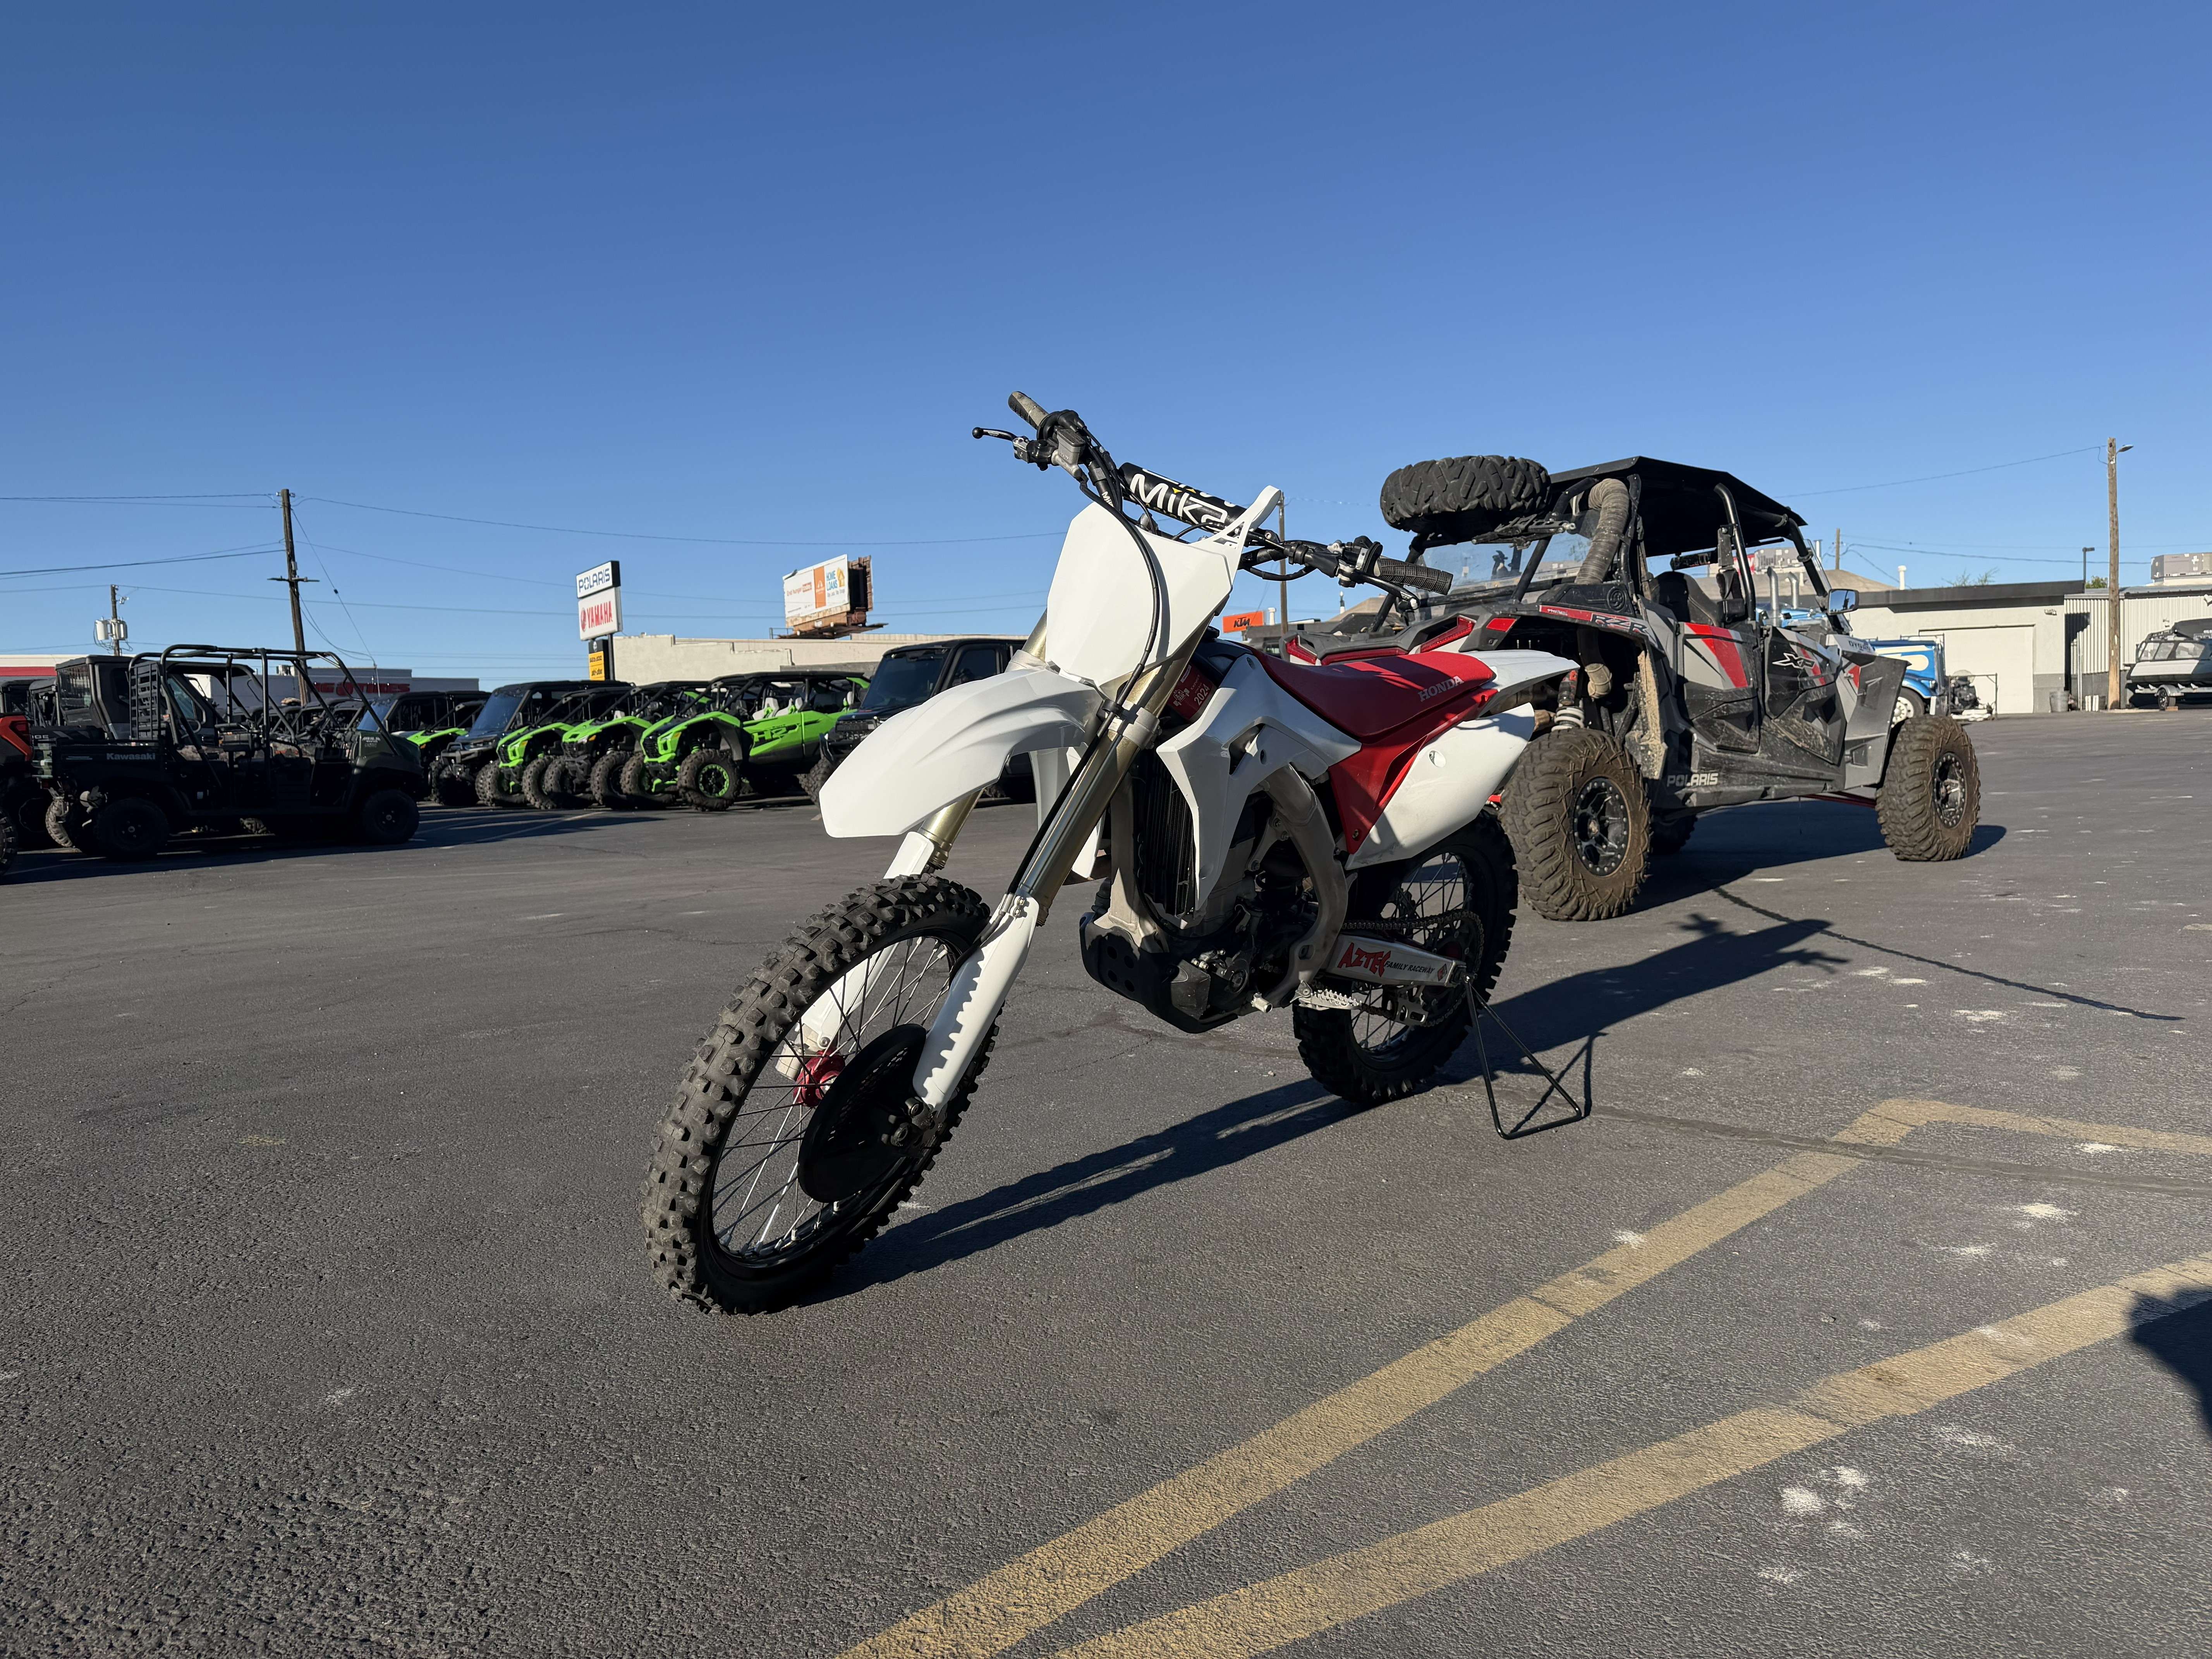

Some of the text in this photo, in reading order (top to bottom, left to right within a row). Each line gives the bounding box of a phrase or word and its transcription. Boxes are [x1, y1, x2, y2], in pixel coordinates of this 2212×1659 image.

[1130, 473, 1228, 532] Mika
[578, 568, 610, 593] POLARIS
[827, 580, 838, 591] LOANS
[587, 601, 613, 629] YAMAHA
[1233, 617, 1250, 628] KTM
[1592, 613, 1650, 636] RZR
[1194, 684, 1210, 706] 2024
[1418, 675, 1465, 702] HONDA
[1666, 773, 1719, 787] POLARIS
[1337, 942, 1435, 977] AZTEC FAMILY RACEWAY
